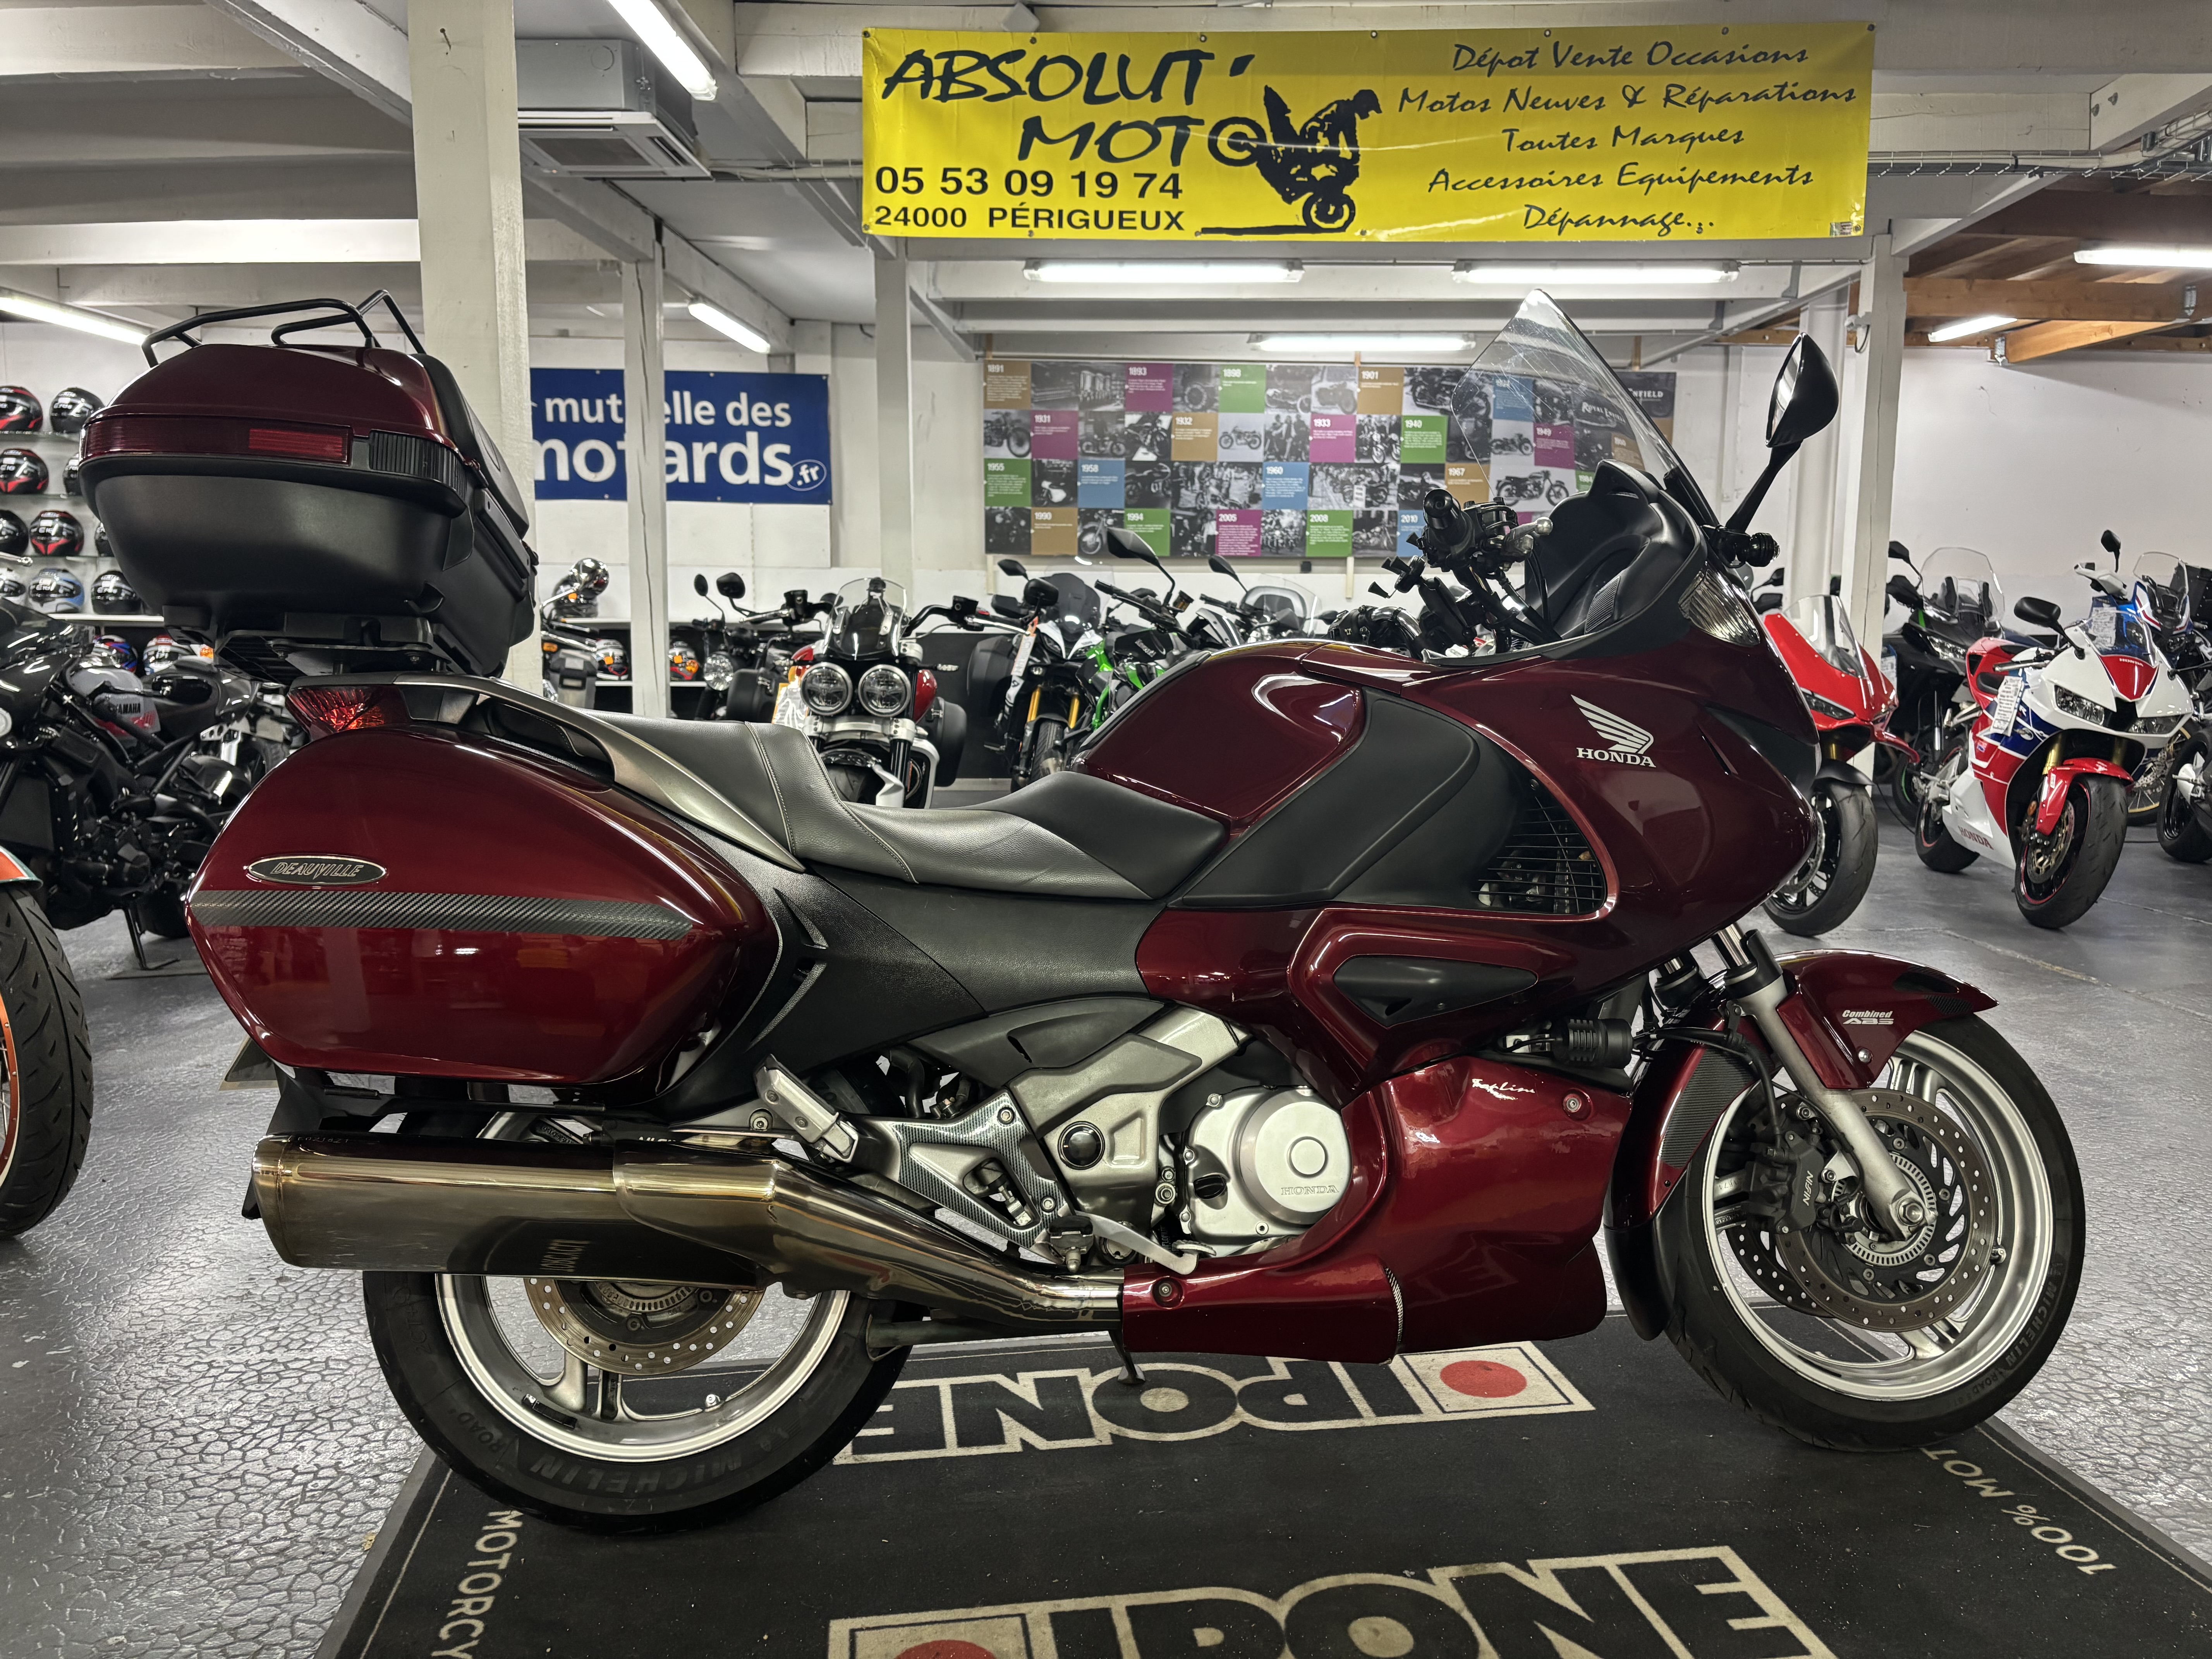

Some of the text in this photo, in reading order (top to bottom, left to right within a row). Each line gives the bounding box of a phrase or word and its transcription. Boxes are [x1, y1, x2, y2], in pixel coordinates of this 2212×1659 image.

[1453, 40, 1809, 77] Dépot Vente Occasions
[1398, 81, 1856, 113] Motos Neuves & Réparations
[1502, 125, 1745, 154] Toutes Marques
[876, 166, 1183, 199] 05 53 09 19 74
[1428, 162, 1813, 196] Accessoires Equipements
[875, 203, 1185, 231] 24000 PÉRIGUEUX
[545, 391, 792, 427] mutlle des
[2119, 658, 2143, 666] HONDA
[117, 703, 141, 714] AMAHA
[1576, 747, 1656, 768] HONDA
[1958, 826, 1994, 850] HONDA
[270, 862, 364, 880] DEAUVILLE
[1842, 1010, 1893, 1018] Combined
[1281, 1185, 1339, 1195] HONDA
[1803, 1170, 1814, 1206] NISSIN
[2005, 1281, 2057, 1367] MICHELIN
[459, 1412, 504, 1453] ROAD
[529, 1450, 742, 1493] MICHELIN
[2001, 1504, 2116, 1575] 100%
